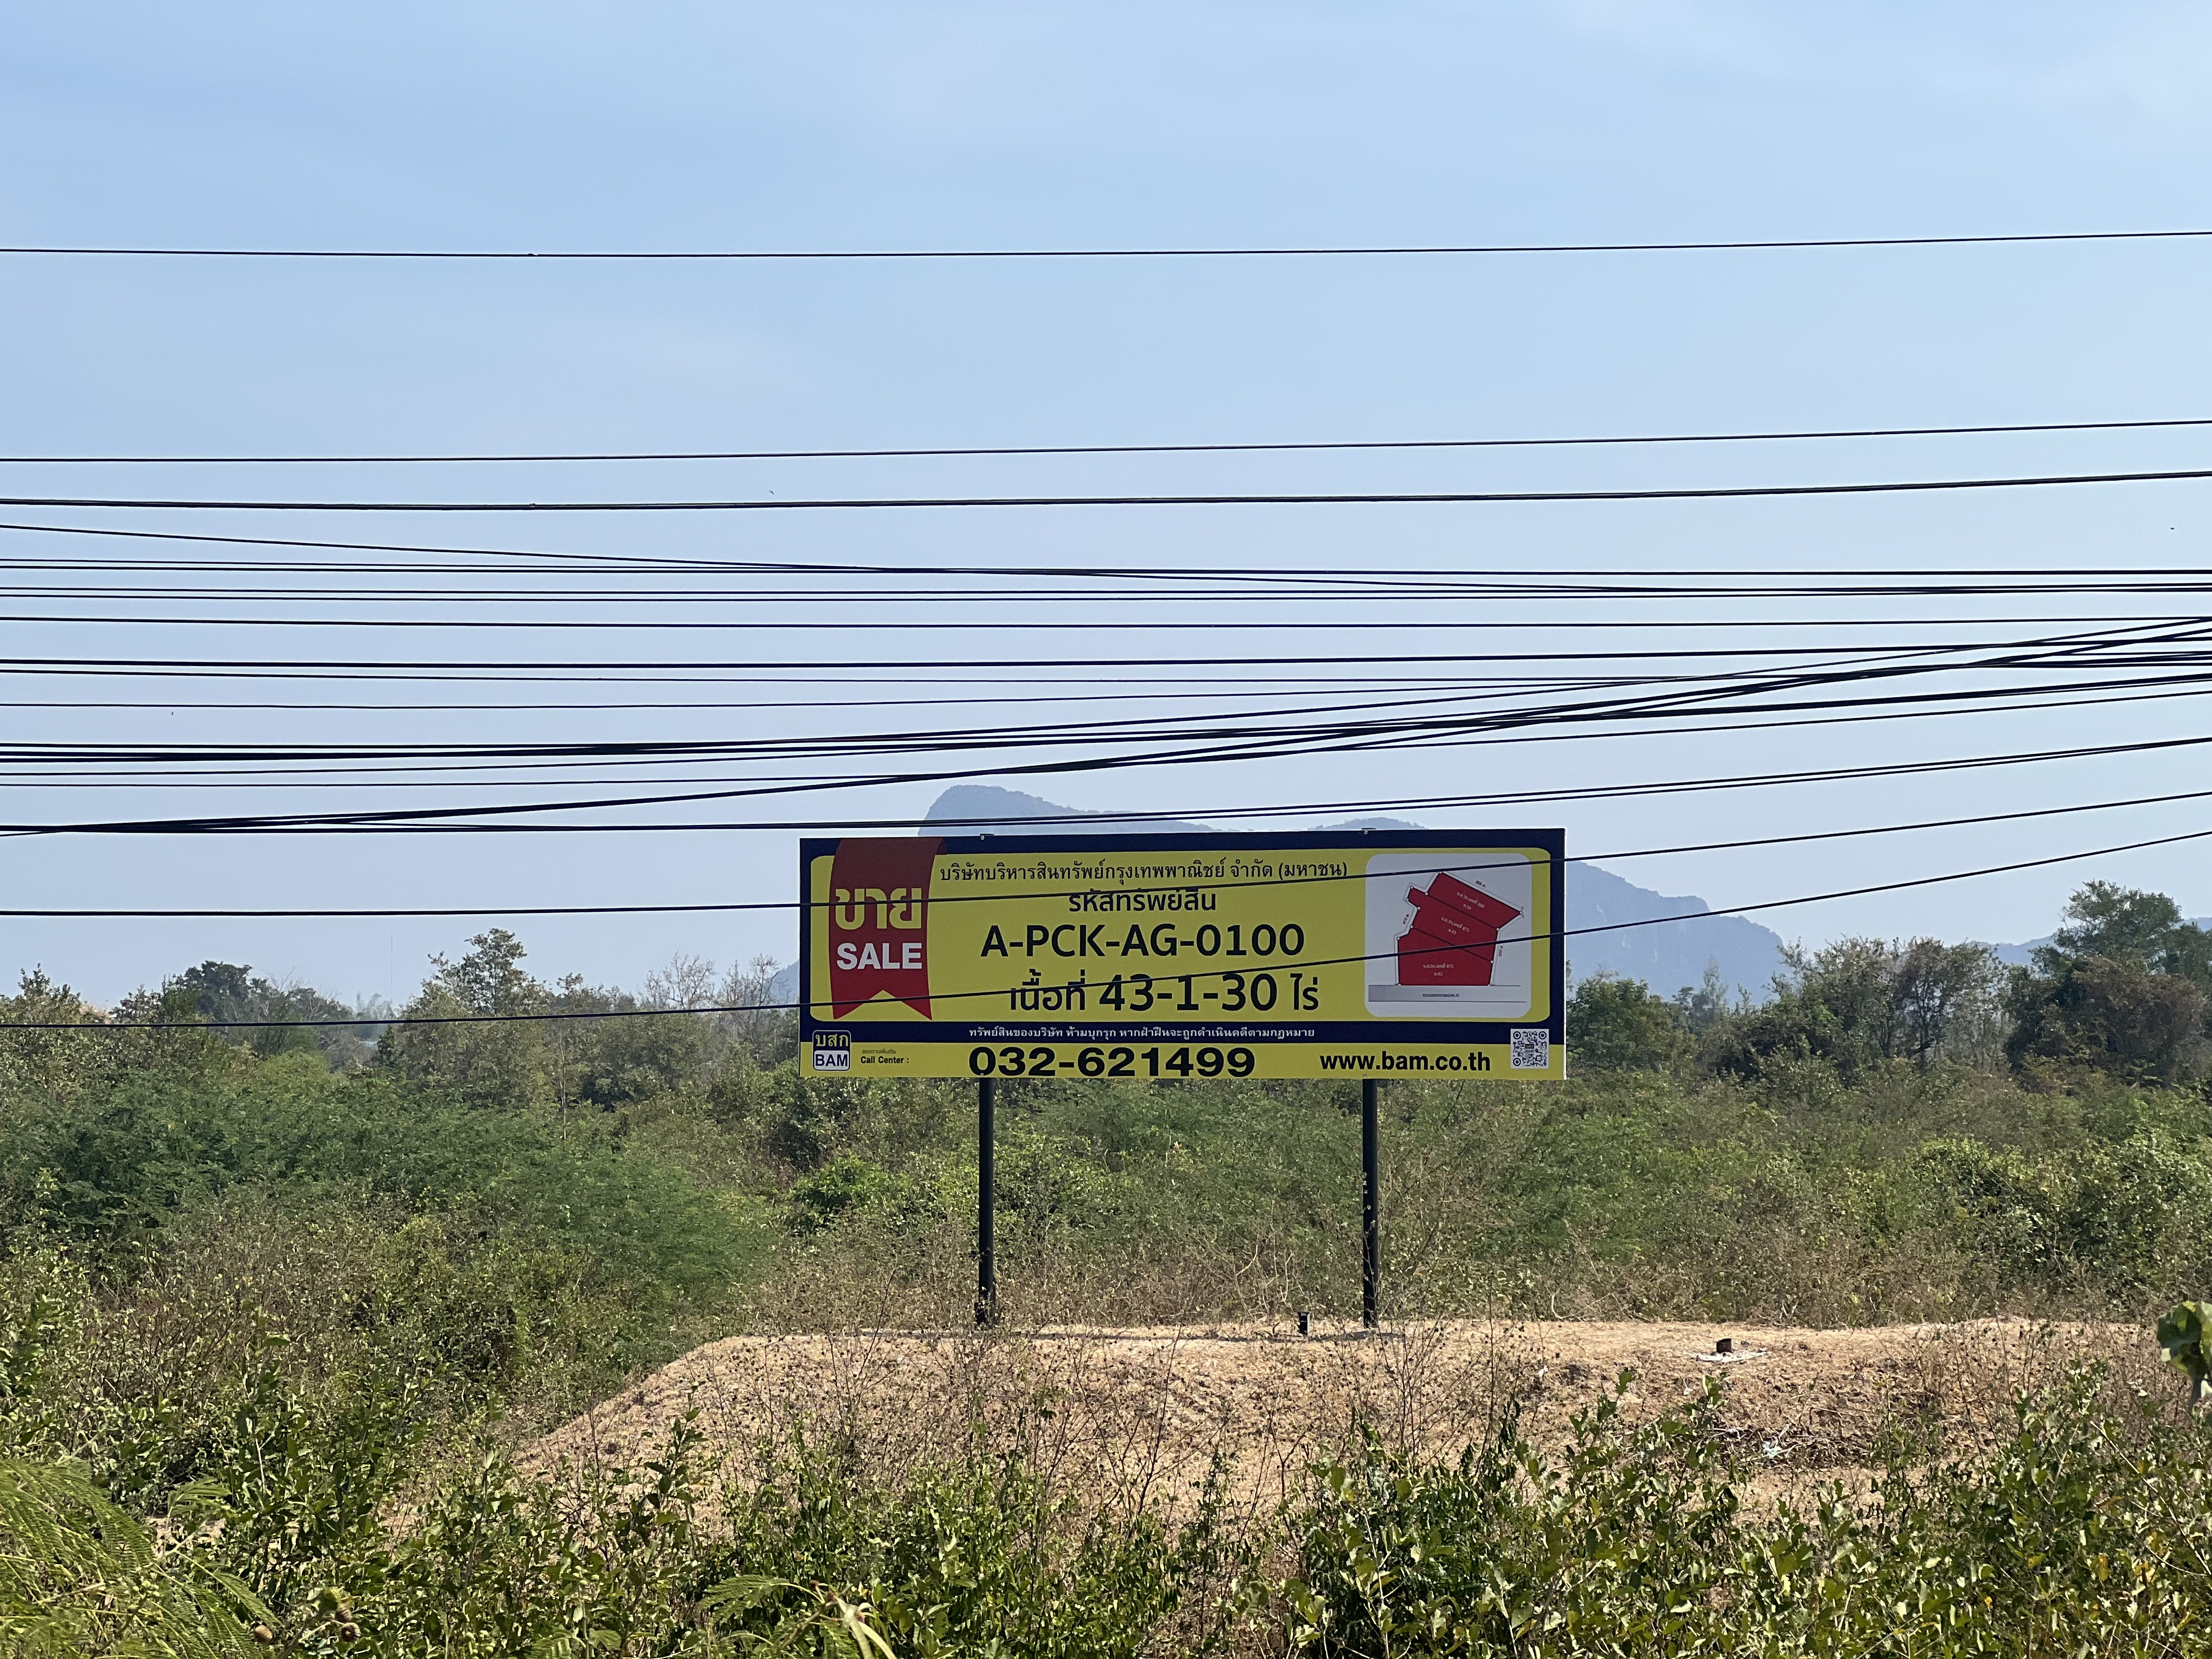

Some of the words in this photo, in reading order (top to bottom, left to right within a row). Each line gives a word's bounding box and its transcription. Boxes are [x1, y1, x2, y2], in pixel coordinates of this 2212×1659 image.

[940, 856, 1227, 885] บริษัทบริหารสินทรัพย์กรุงเทพพาณิชย์
[1230, 859, 1273, 878] จำกัด
[1278, 861, 1347, 881] (มหาชน)
[835, 888, 922, 930] ขาย
[1069, 885, 1216, 912] รหัสทรพยสิน
[980, 923, 1305, 957] A-PCK-AG-0100
[837, 943, 922, 970] SALE
[1011, 968, 1086, 1011] เนื้อที่
[1099, 973, 1277, 1011] 43-1-30
[1290, 973, 1319, 1011] ไร่
[815, 1033, 849, 1047] บสก
[969, 1025, 1063, 1037] ทรัพย์สินของบริษัท
[1065, 1025, 1116, 1040] ห้ามบุกรุก
[815, 1054, 848, 1067] BAM
[860, 1056, 875, 1064] Call
[878, 1056, 905, 1064] Center
[968, 1046, 1255, 1077] 032-621499
[1319, 1050, 1491, 1071] www.bam.co.th
